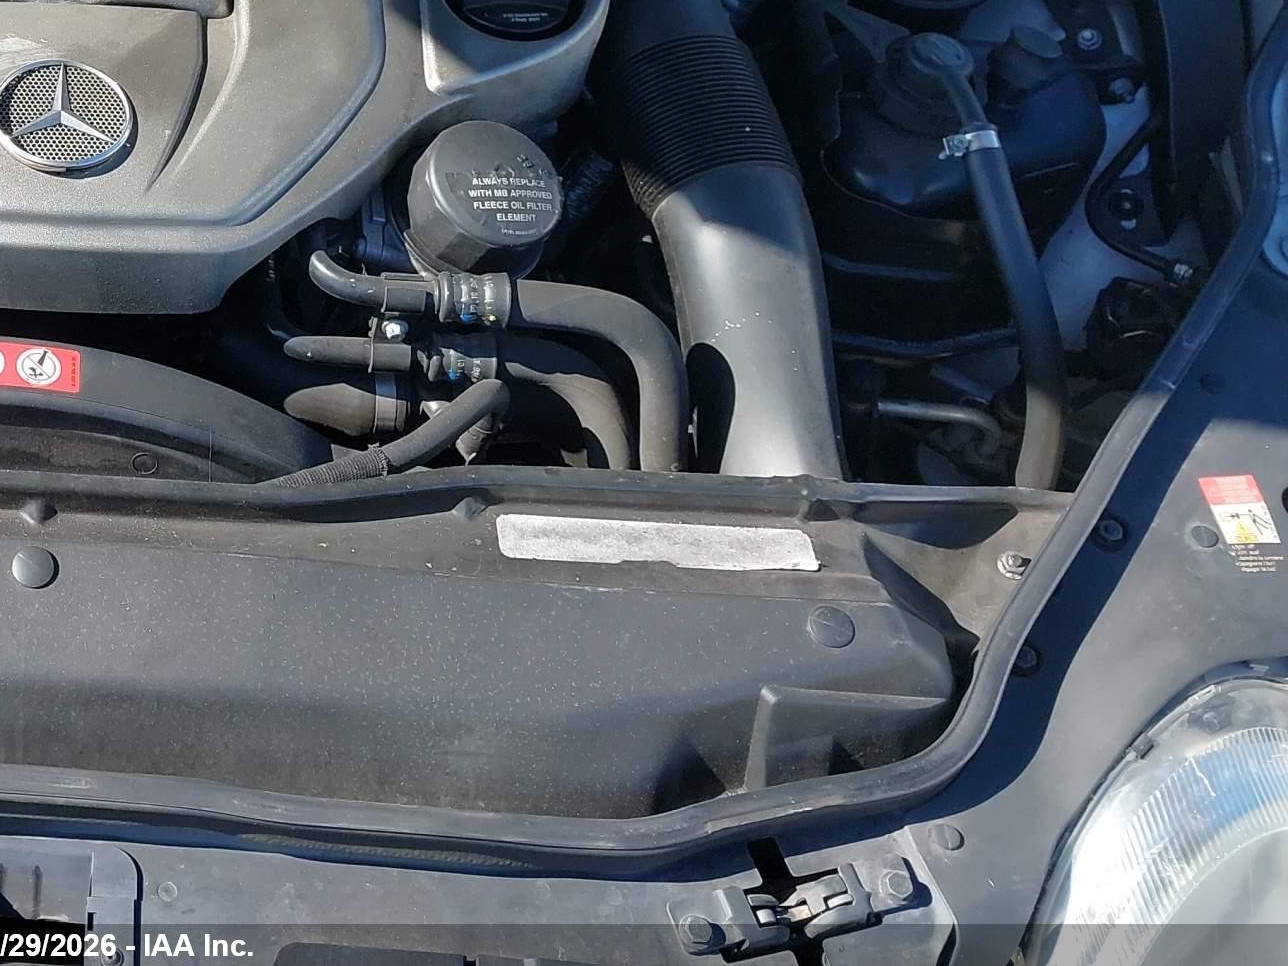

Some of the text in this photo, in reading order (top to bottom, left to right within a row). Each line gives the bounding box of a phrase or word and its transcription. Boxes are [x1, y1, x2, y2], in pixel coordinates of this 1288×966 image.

[472, 177, 545, 187] ALWAYS REPLACE
[468, 189, 552, 200] WITH MB APPROVED
[473, 201, 552, 211] FLEECE OIL FILTER
[496, 213, 536, 222] ELEMENT
